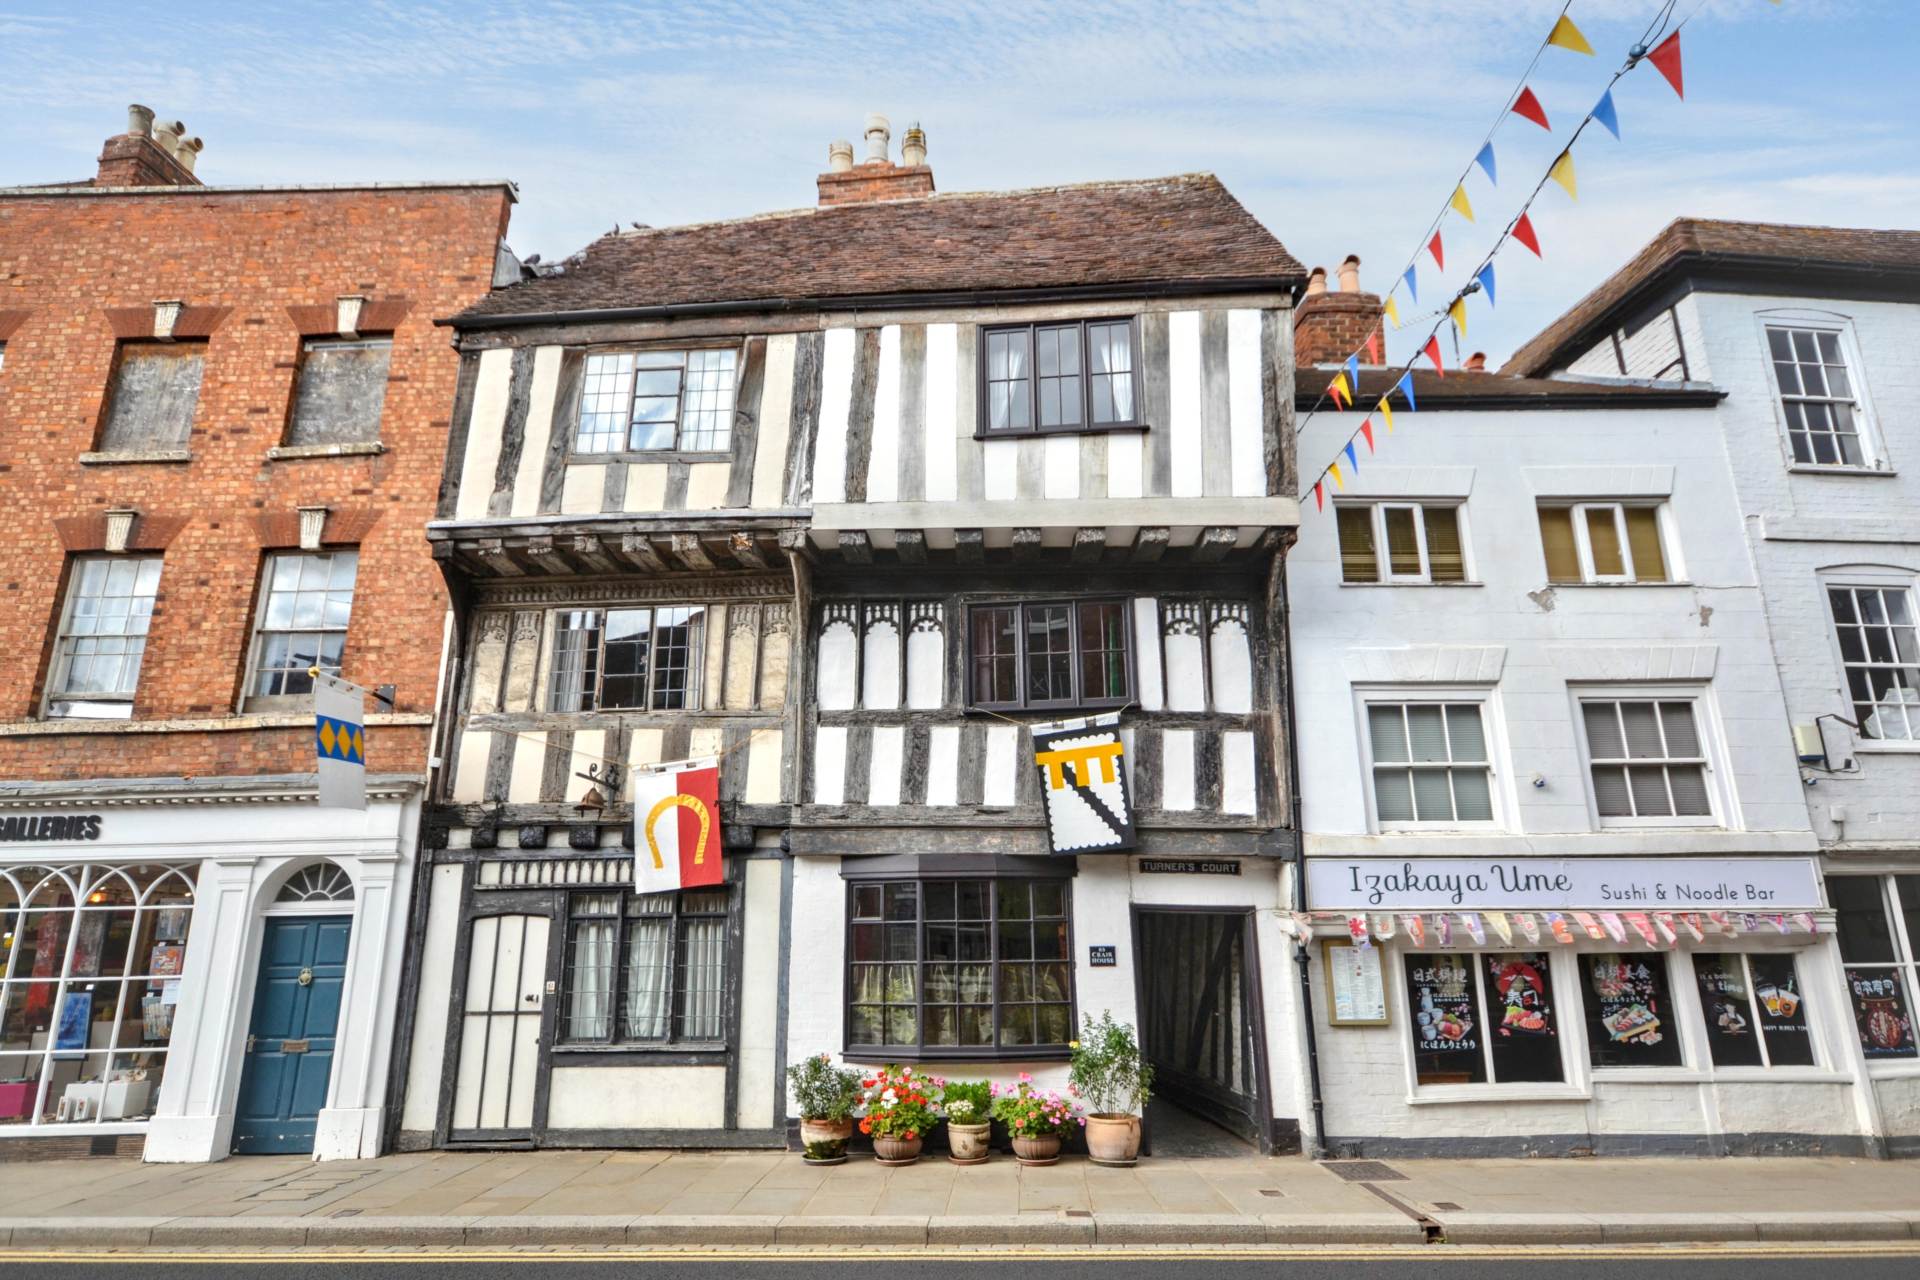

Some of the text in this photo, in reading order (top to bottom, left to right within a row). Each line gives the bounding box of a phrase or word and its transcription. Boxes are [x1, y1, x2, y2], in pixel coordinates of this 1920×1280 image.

[1201, 863, 1237, 872] COURT
[1348, 863, 1572, 904] Izakaya Ume
[1600, 883, 1775, 900] Sushi & Noodle Bar
